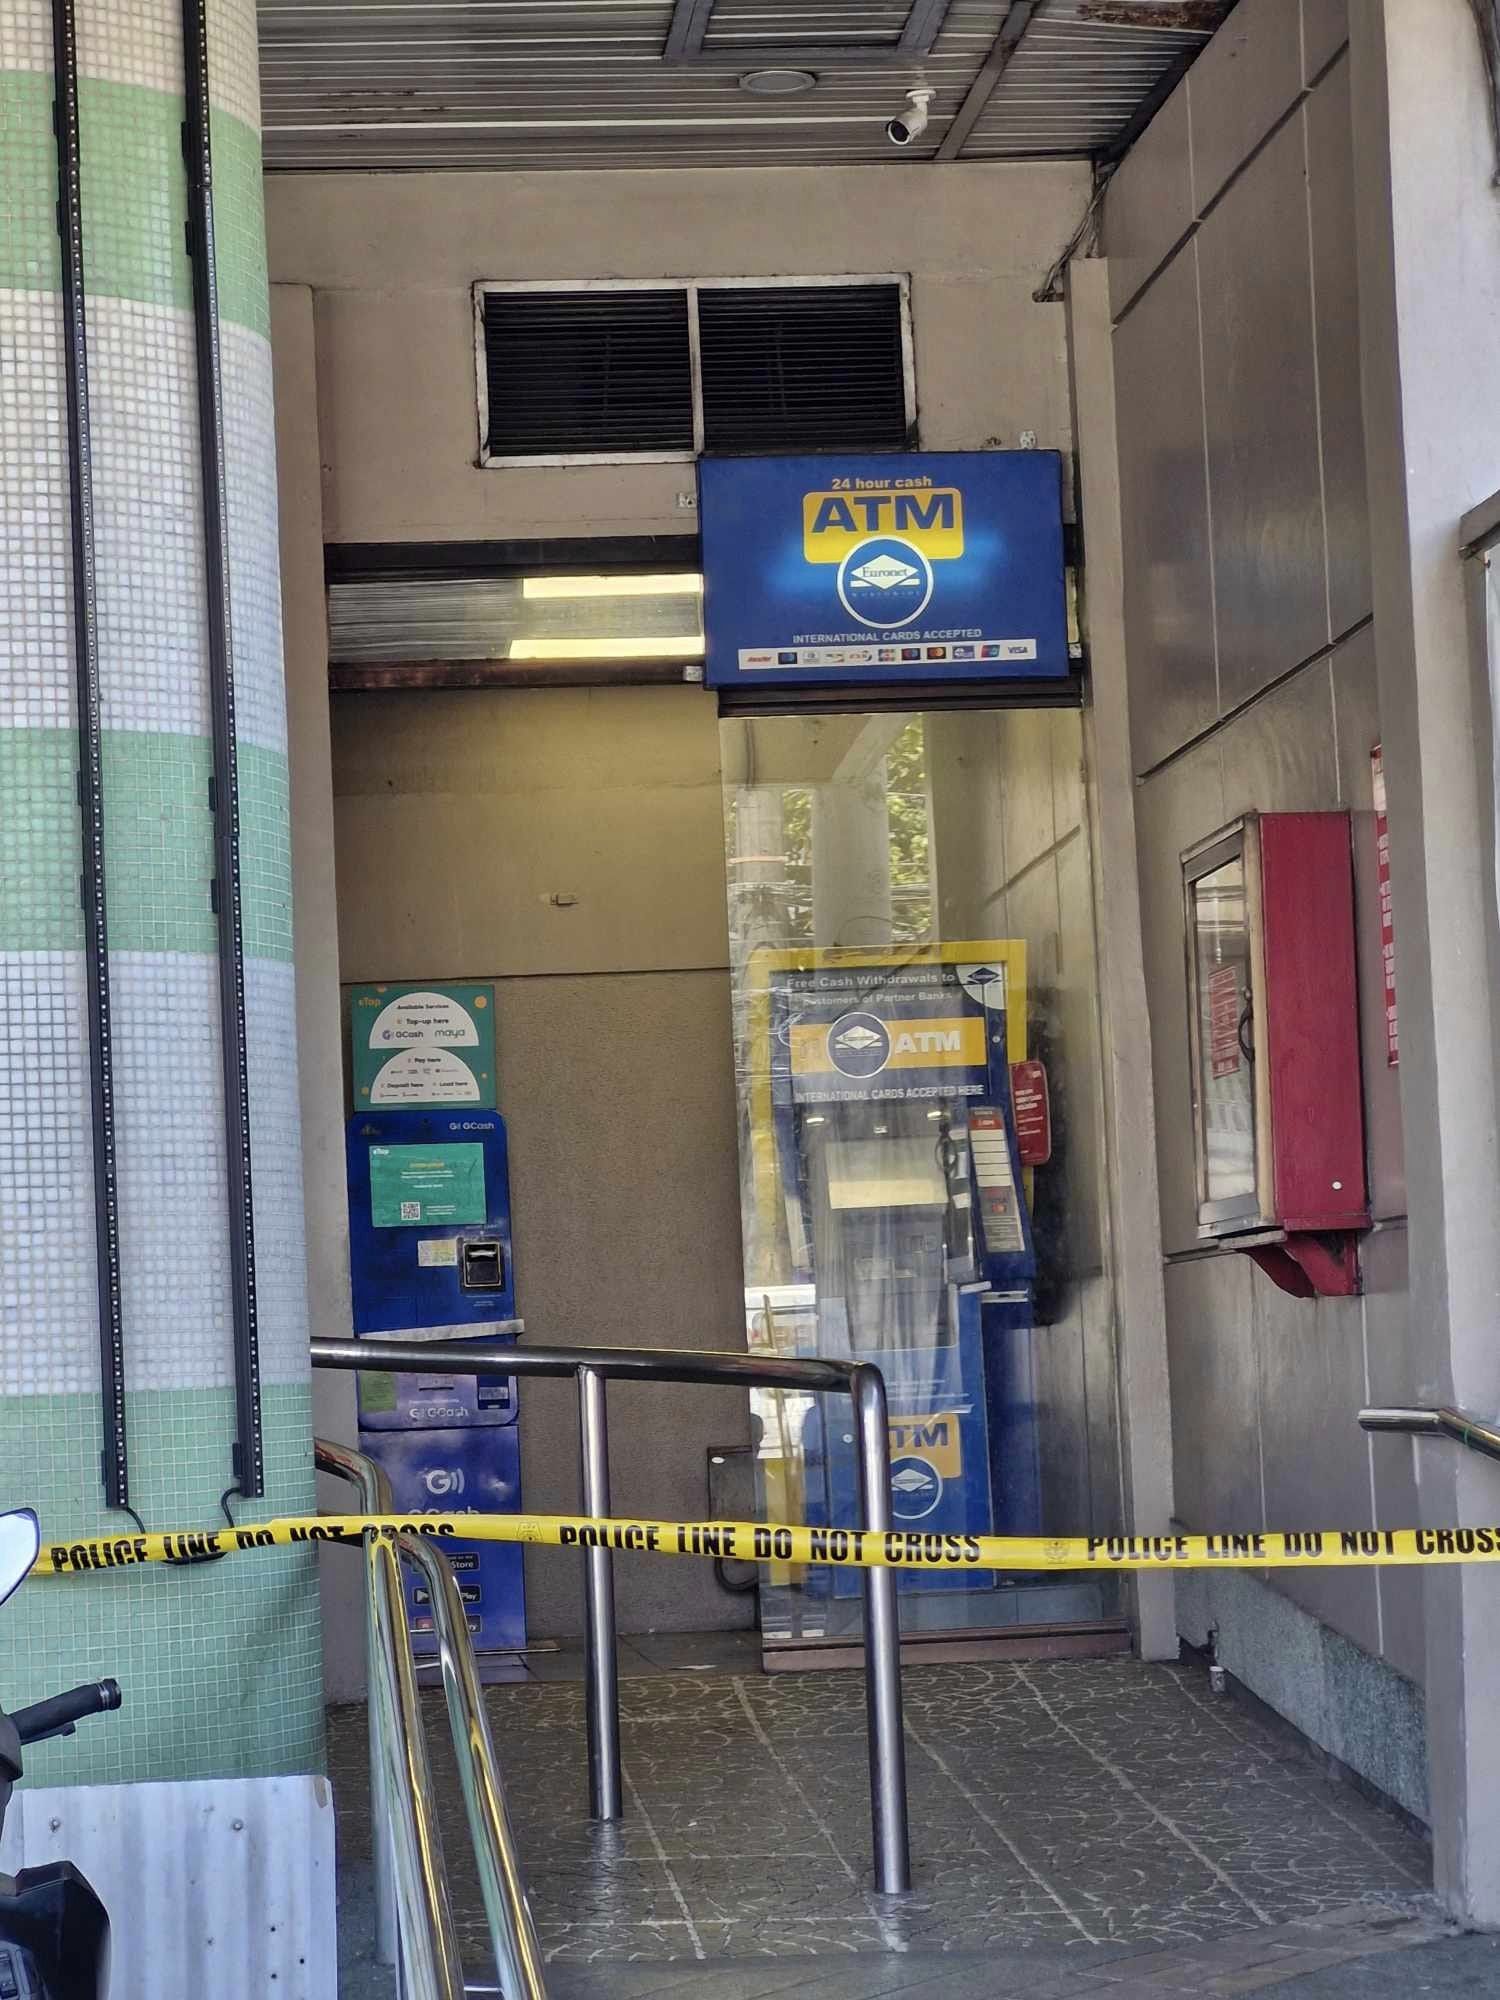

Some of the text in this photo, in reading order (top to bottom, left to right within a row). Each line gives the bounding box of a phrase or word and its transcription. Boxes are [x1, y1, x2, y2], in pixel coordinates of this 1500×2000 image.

[832, 475, 932, 490] 24 hour cash
[812, 494, 954, 533] ATM
[792, 628, 982, 644] INTERNATIONAL CARDS ACCEPTED
[1008, 646, 1028, 654] VISA
[786, 972, 955, 989] Free Cash Withdrawals to
[863, 994, 873, 1003] of
[876, 991, 915, 1003] Partner
[918, 990, 953, 1001] Banks
[406, 1018, 431, 1026] Top-up
[434, 1028, 466, 1039] maya
[895, 1031, 961, 1054] ATM
[795, 1084, 985, 1104] INTERNATIONAL CARDS ACCEPTED HERE
[462, 1121, 495, 1130] GCash
[427, 1406, 469, 1418] GCash
[888, 1422, 948, 1449] TM
[50, 1538, 147, 1572] POLICE
[163, 1532, 221, 1559] LINE
[559, 1525, 981, 1563] POLICE LINE DO NOT CROSS
[1087, 1536, 1189, 1561] POLICE
[1206, 1534, 1266, 1559] LINE
[1283, 1532, 1322, 1558] DO
[1341, 1530, 1394, 1557] NOT
[451, 1559, 474, 1569] Store
